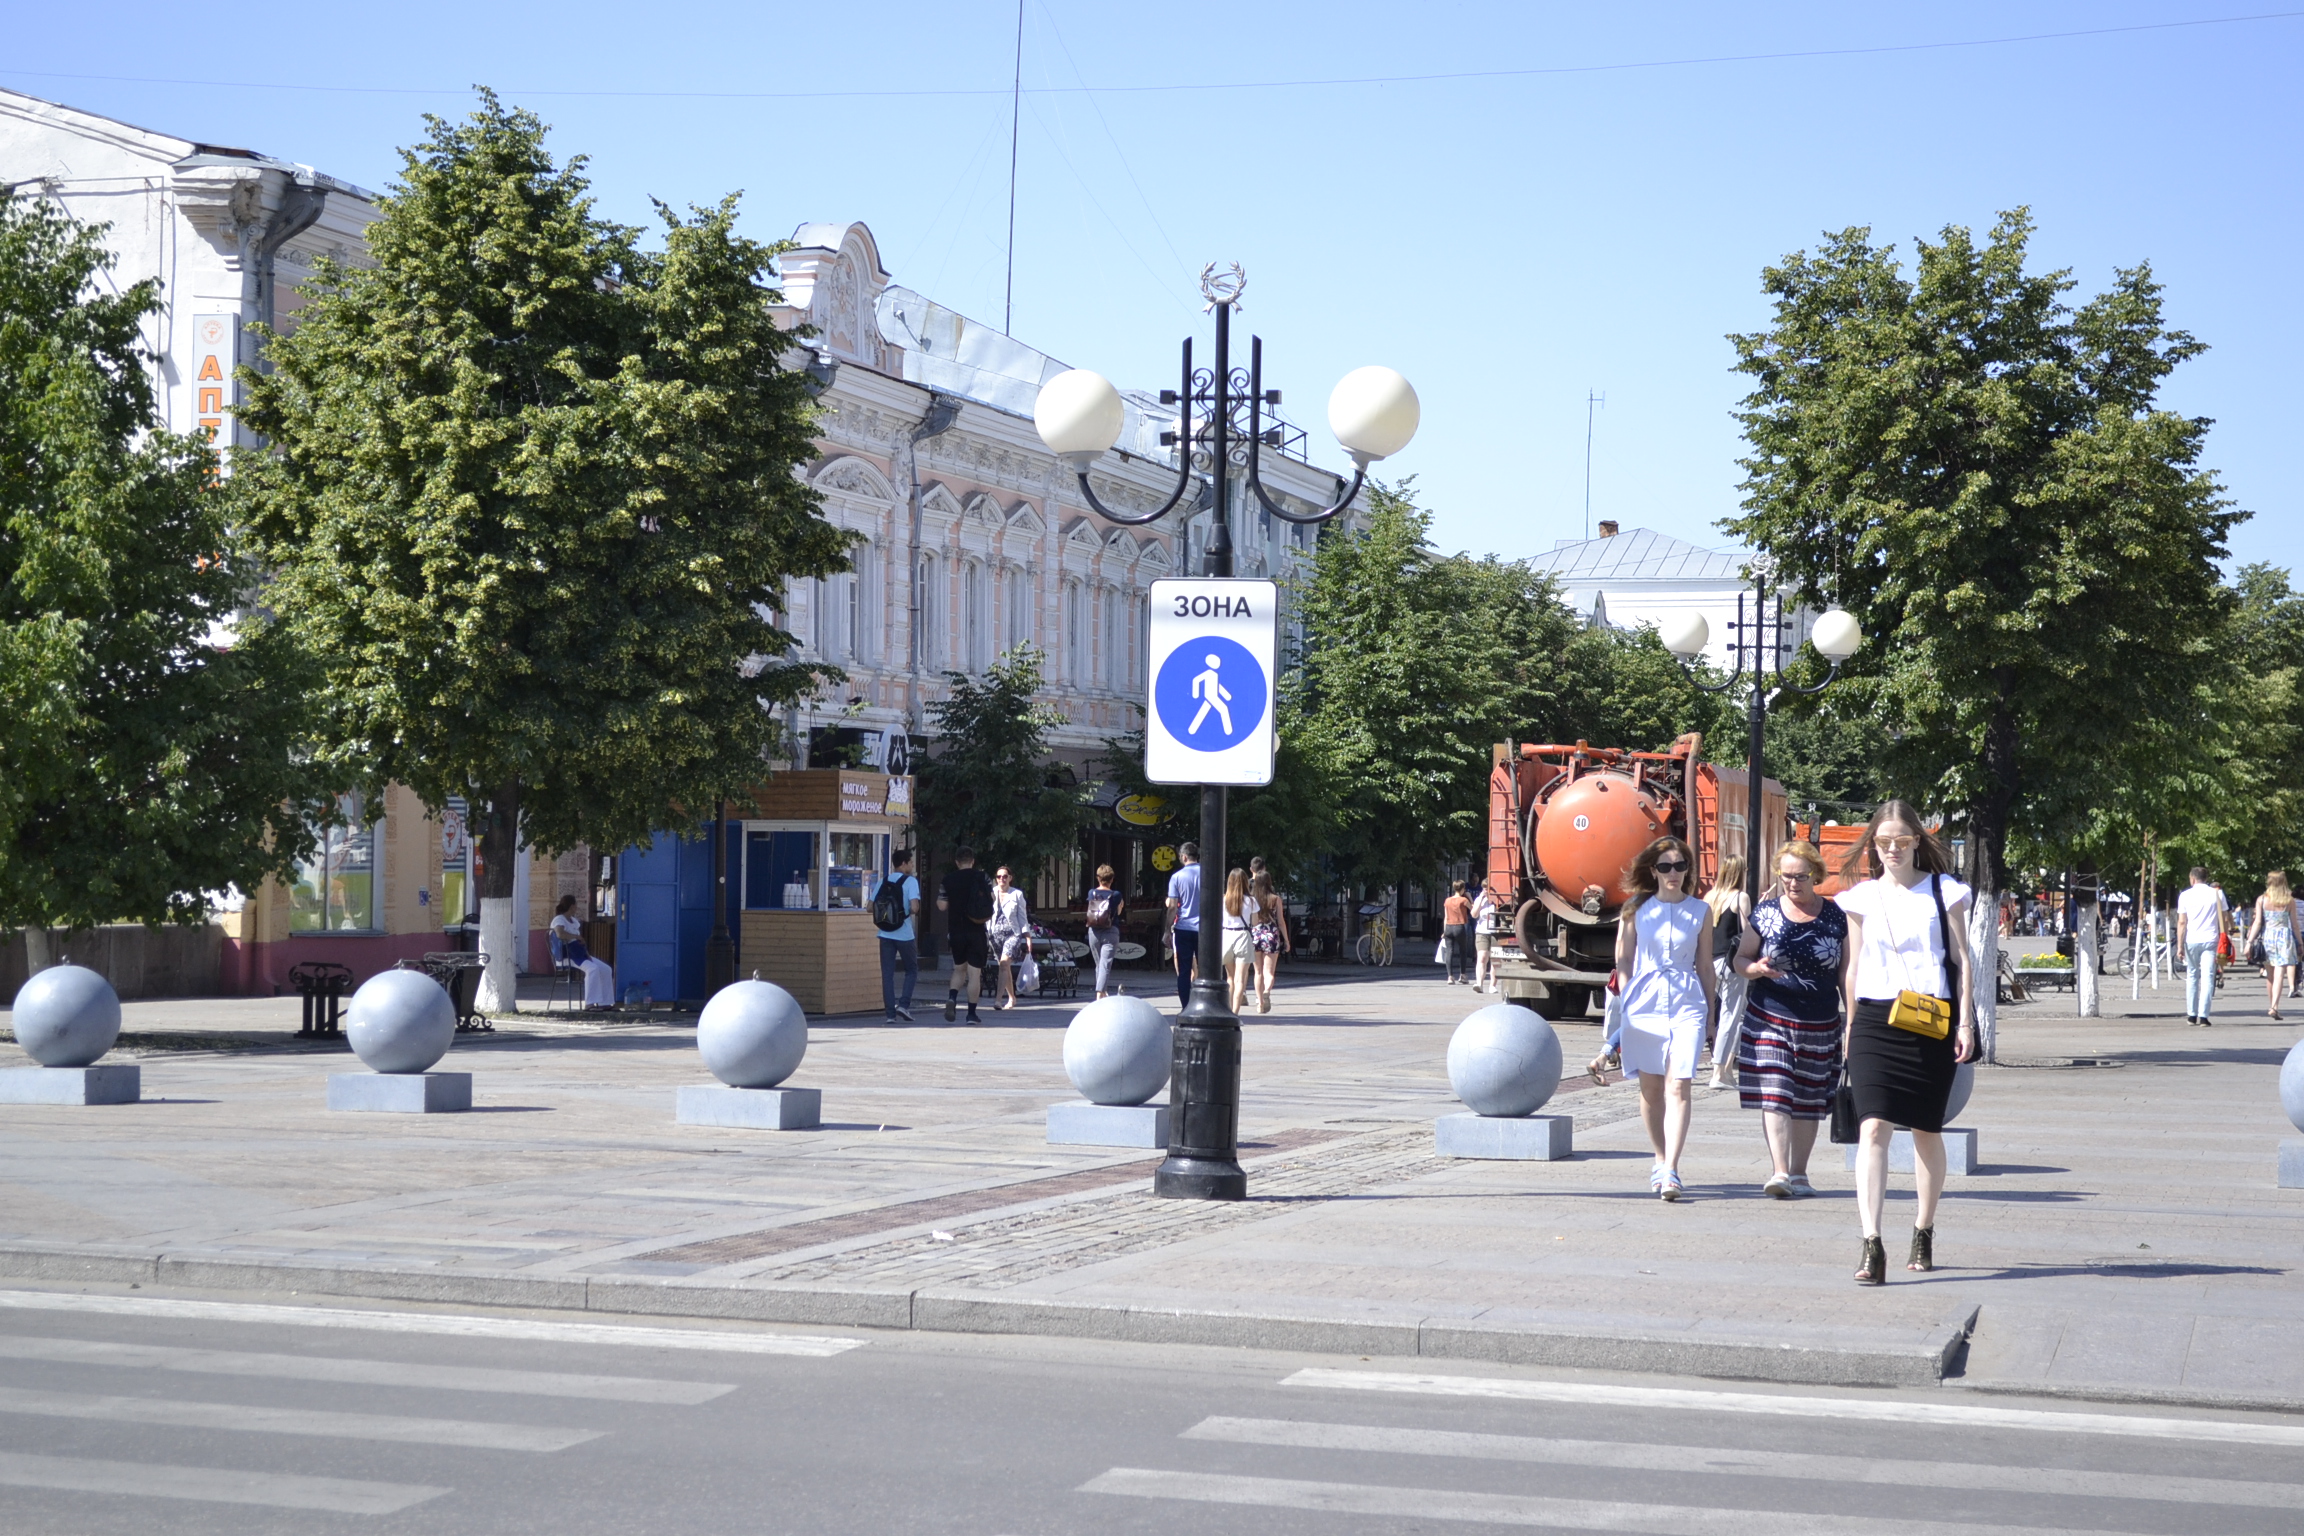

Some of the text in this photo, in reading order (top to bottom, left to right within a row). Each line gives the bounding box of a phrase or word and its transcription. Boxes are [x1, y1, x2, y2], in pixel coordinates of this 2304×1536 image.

[1173, 595, 1252, 618] ЗОНА
[842, 782, 868, 797] мягкое
[842, 799, 882, 816] мороженое
[1575, 817, 1587, 828] 40
